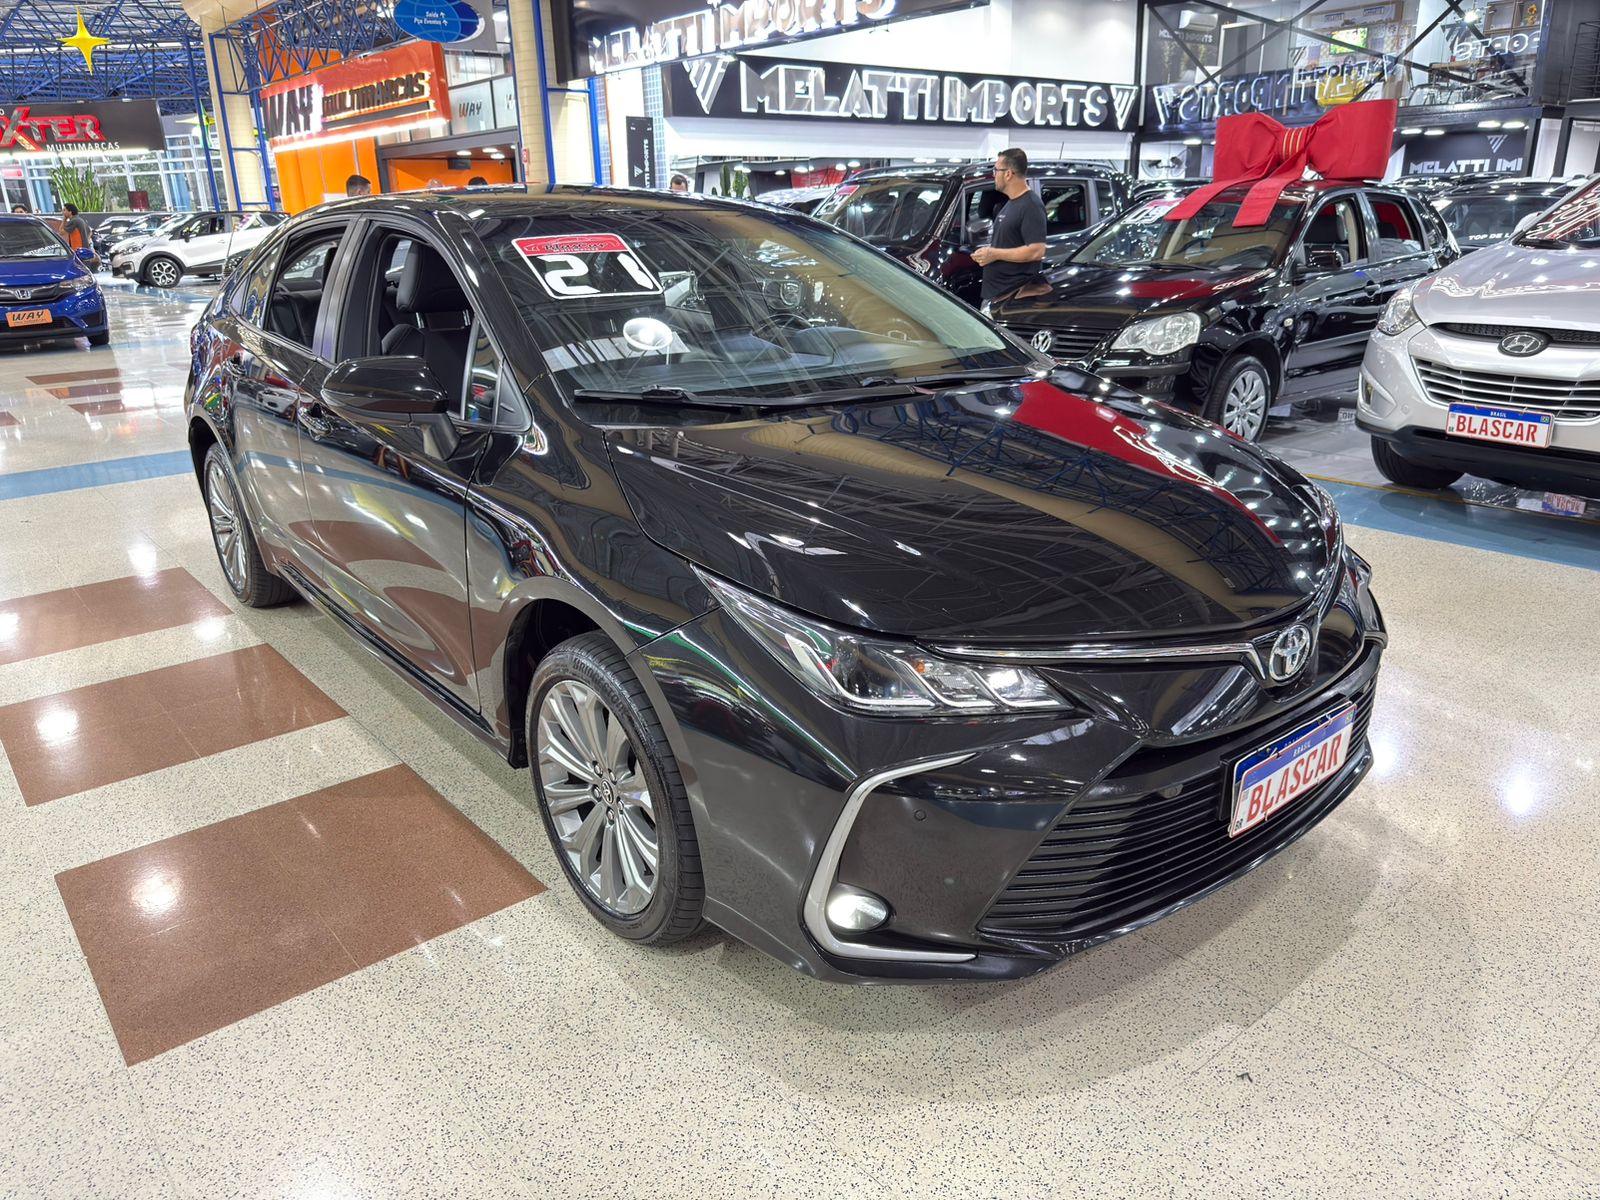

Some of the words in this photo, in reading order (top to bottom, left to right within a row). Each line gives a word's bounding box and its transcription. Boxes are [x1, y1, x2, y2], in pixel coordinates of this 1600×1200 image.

[588, 9, 717, 75] MELATTI
[262, 83, 314, 138] WAY
[458, 101, 482, 118] WAY
[739, 60, 940, 121] MELATTI
[942, 75, 1109, 128] IMPORTS
[46, 141, 120, 152] MULTIMARCAS
[1408, 158, 1491, 174] MELATTI
[537, 253, 654, 295] 21
[12, 311, 44, 322] WAY
[1456, 415, 1538, 442] BLASCAR
[1246, 733, 1342, 823] BLASCAR
